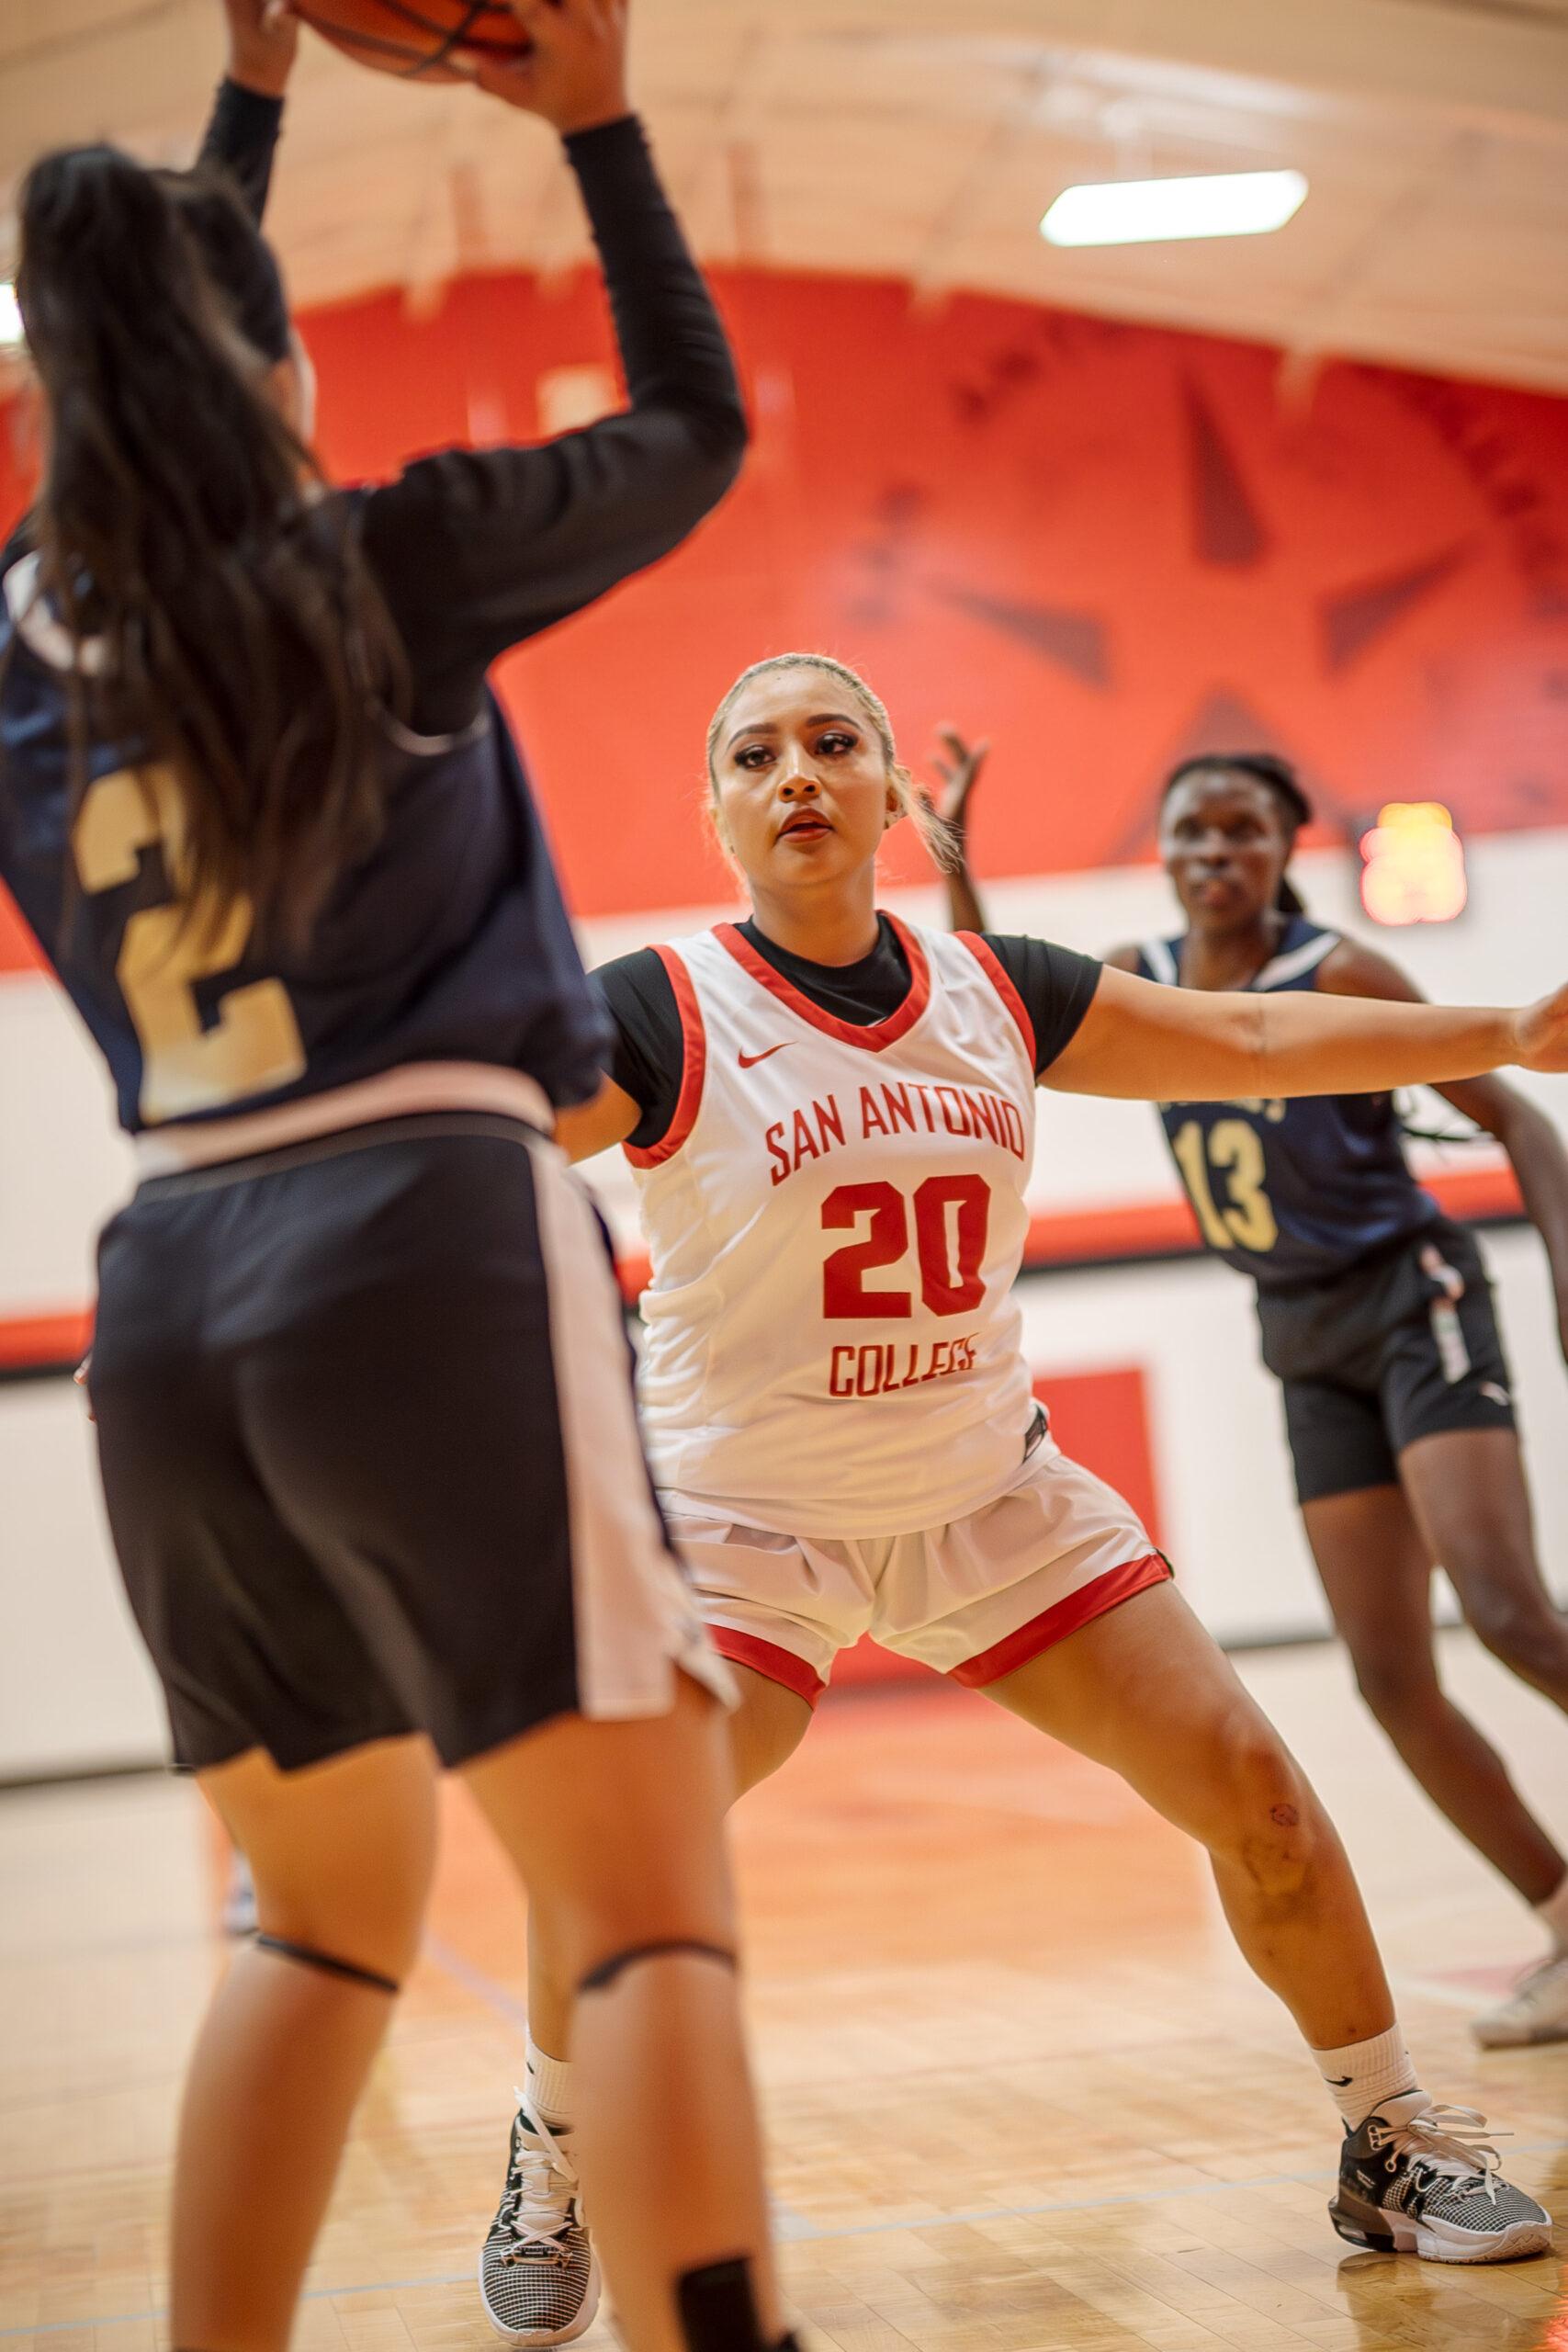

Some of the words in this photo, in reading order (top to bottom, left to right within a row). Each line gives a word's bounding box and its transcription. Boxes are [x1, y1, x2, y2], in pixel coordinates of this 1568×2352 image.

[765, 1093, 846, 1187] SAN
[859, 1081, 1025, 1161] ANTONIO
[1171, 1117, 1279, 1254] 13
[820, 1173, 991, 1319] 20
